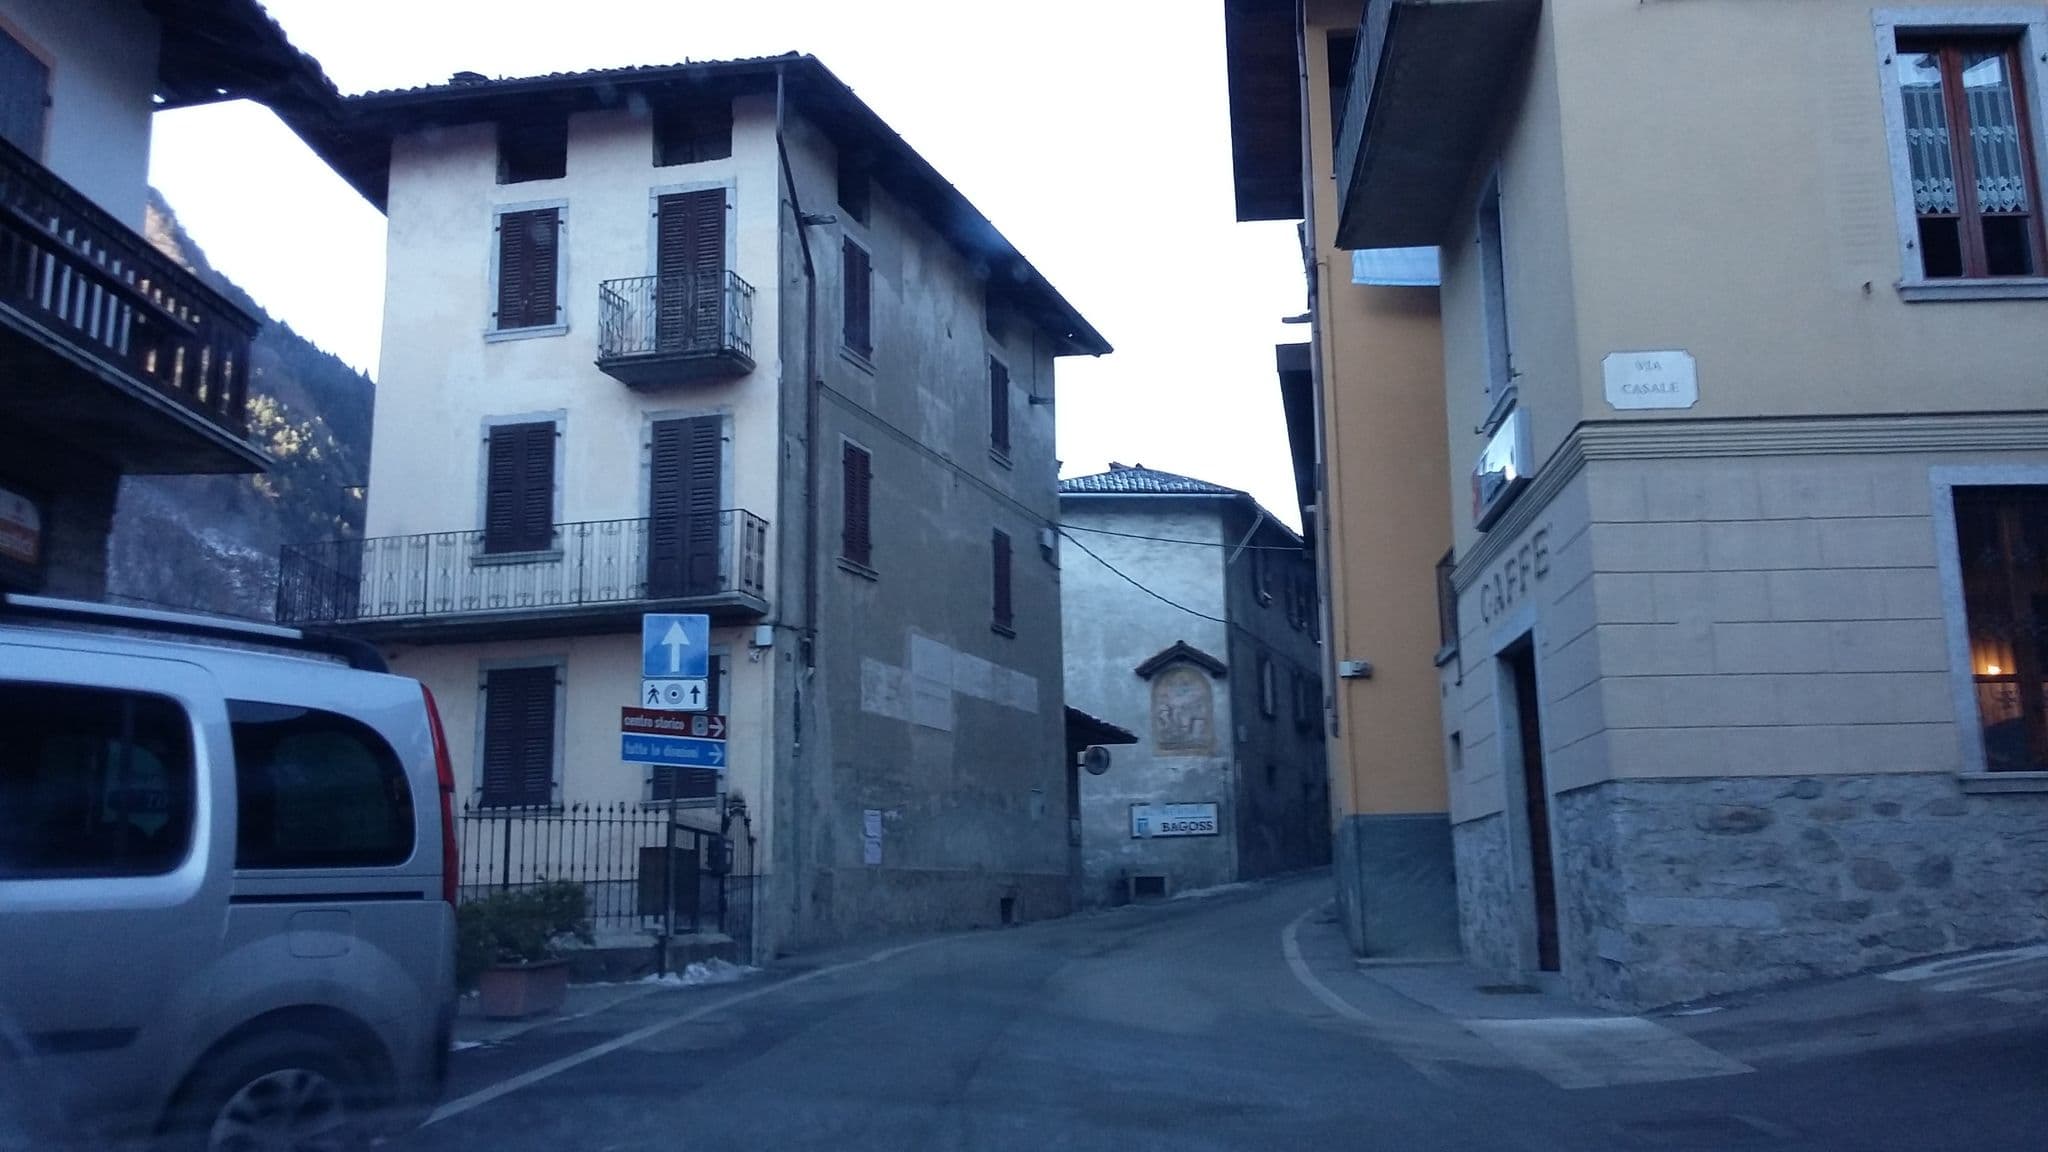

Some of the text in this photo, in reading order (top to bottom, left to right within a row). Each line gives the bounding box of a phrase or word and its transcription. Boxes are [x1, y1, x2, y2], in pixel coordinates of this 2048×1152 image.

[1634, 359, 1662, 371] VIA
[1622, 382, 1680, 395] CASALE
[624, 714, 685, 730] centro storico
[1161, 821, 1213, 832] BAGOSS
